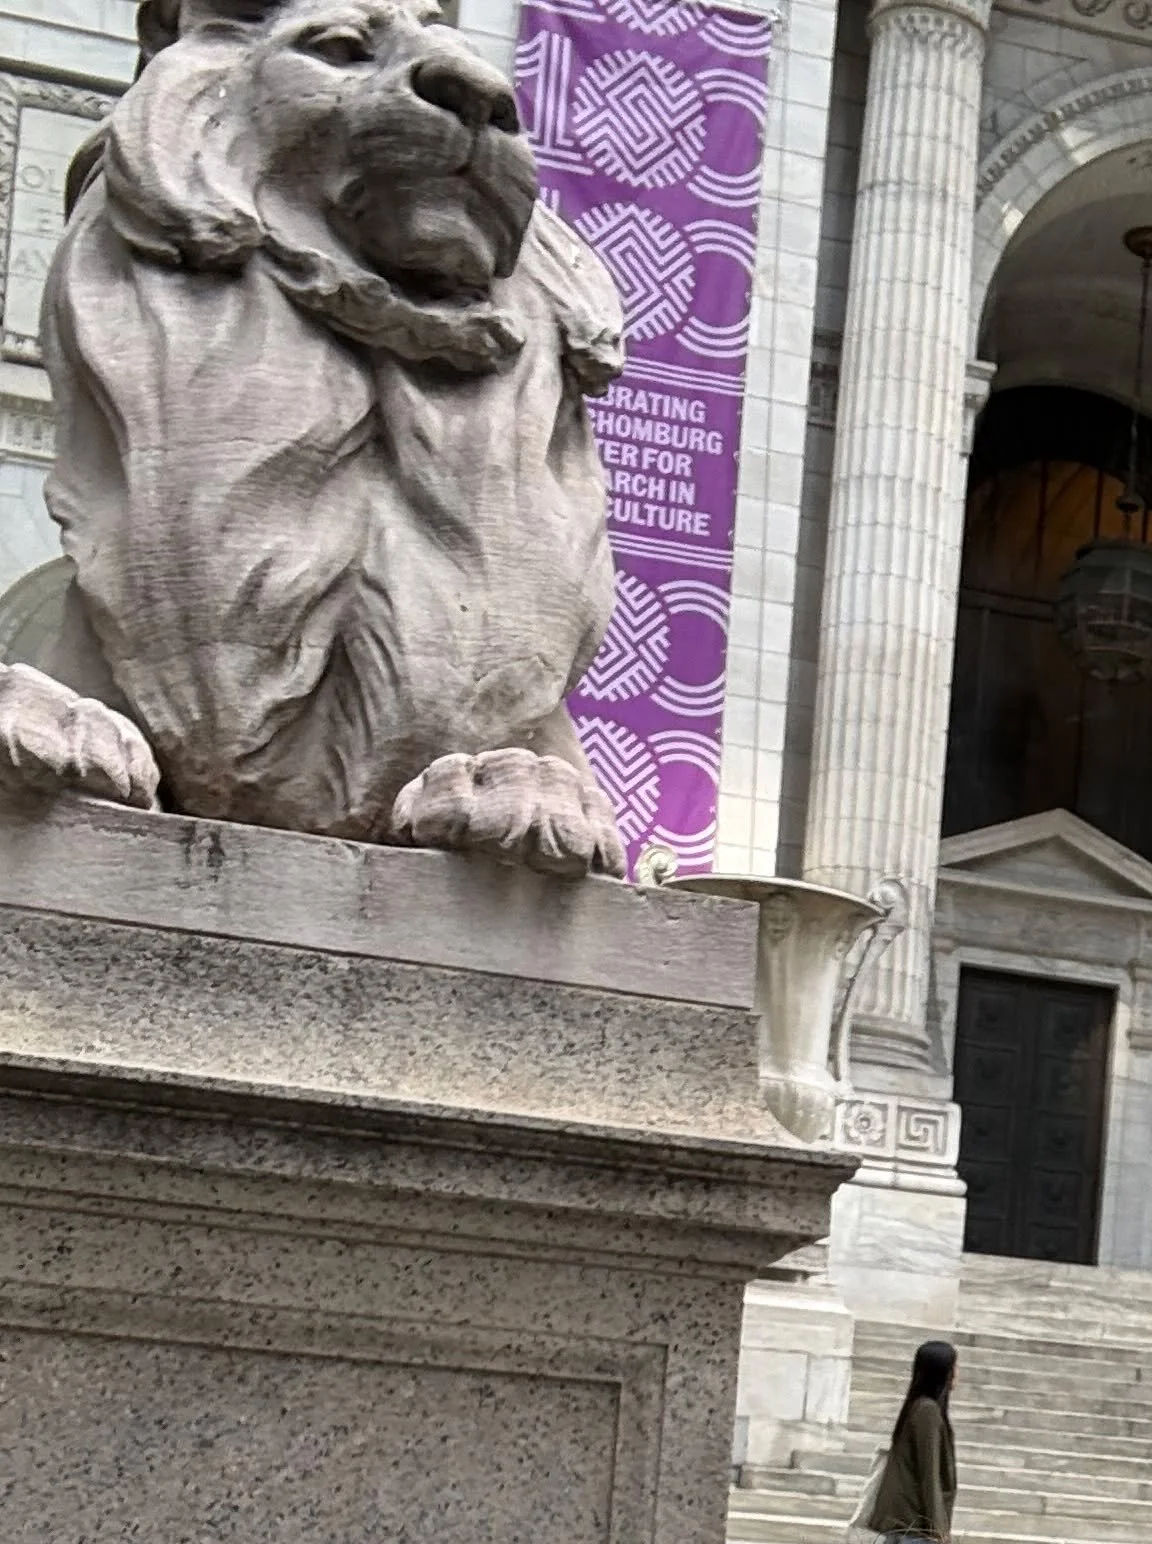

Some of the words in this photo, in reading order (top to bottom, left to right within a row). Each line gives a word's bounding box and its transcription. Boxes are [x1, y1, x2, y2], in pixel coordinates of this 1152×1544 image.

[584, 383, 707, 423] RATING
[641, 446, 693, 477] FOR
[669, 480, 696, 505] IN
